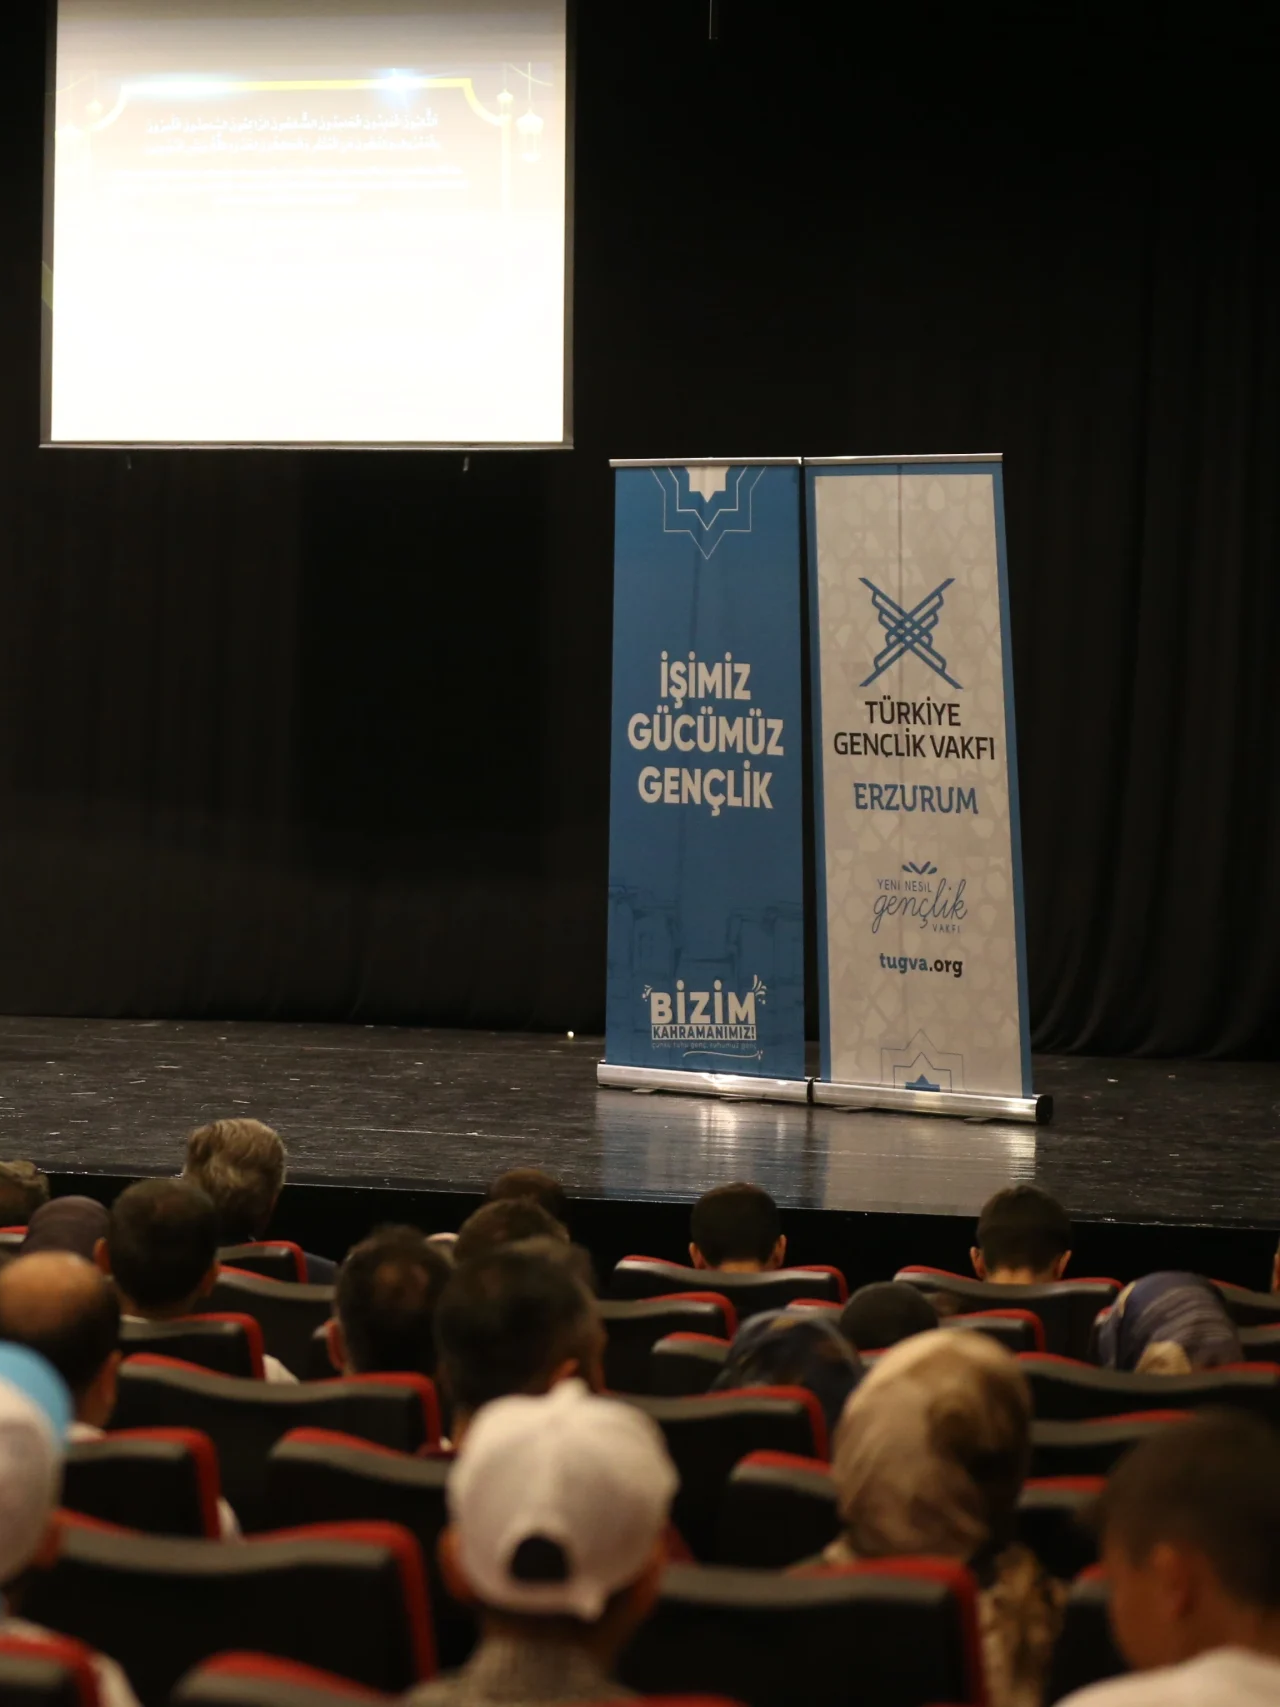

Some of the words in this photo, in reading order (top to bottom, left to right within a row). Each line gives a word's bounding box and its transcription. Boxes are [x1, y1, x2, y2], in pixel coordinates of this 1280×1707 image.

[660, 650, 751, 709] İŞİMİZ
[865, 695, 961, 726] TÜRKİYE
[627, 705, 784, 756] GÜCÜMÜZ
[834, 728, 926, 757] GENÇLİK
[930, 735, 995, 760] VAKFI
[638, 760, 774, 816] GENÇLİK
[853, 783, 979, 814] ERZURUM
[872, 878, 968, 933] gençlik
[879, 952, 963, 978] tugva.org
[651, 980, 755, 1024] BİZİM
[652, 1026, 755, 1039] KAHRAMANIMIZ!
